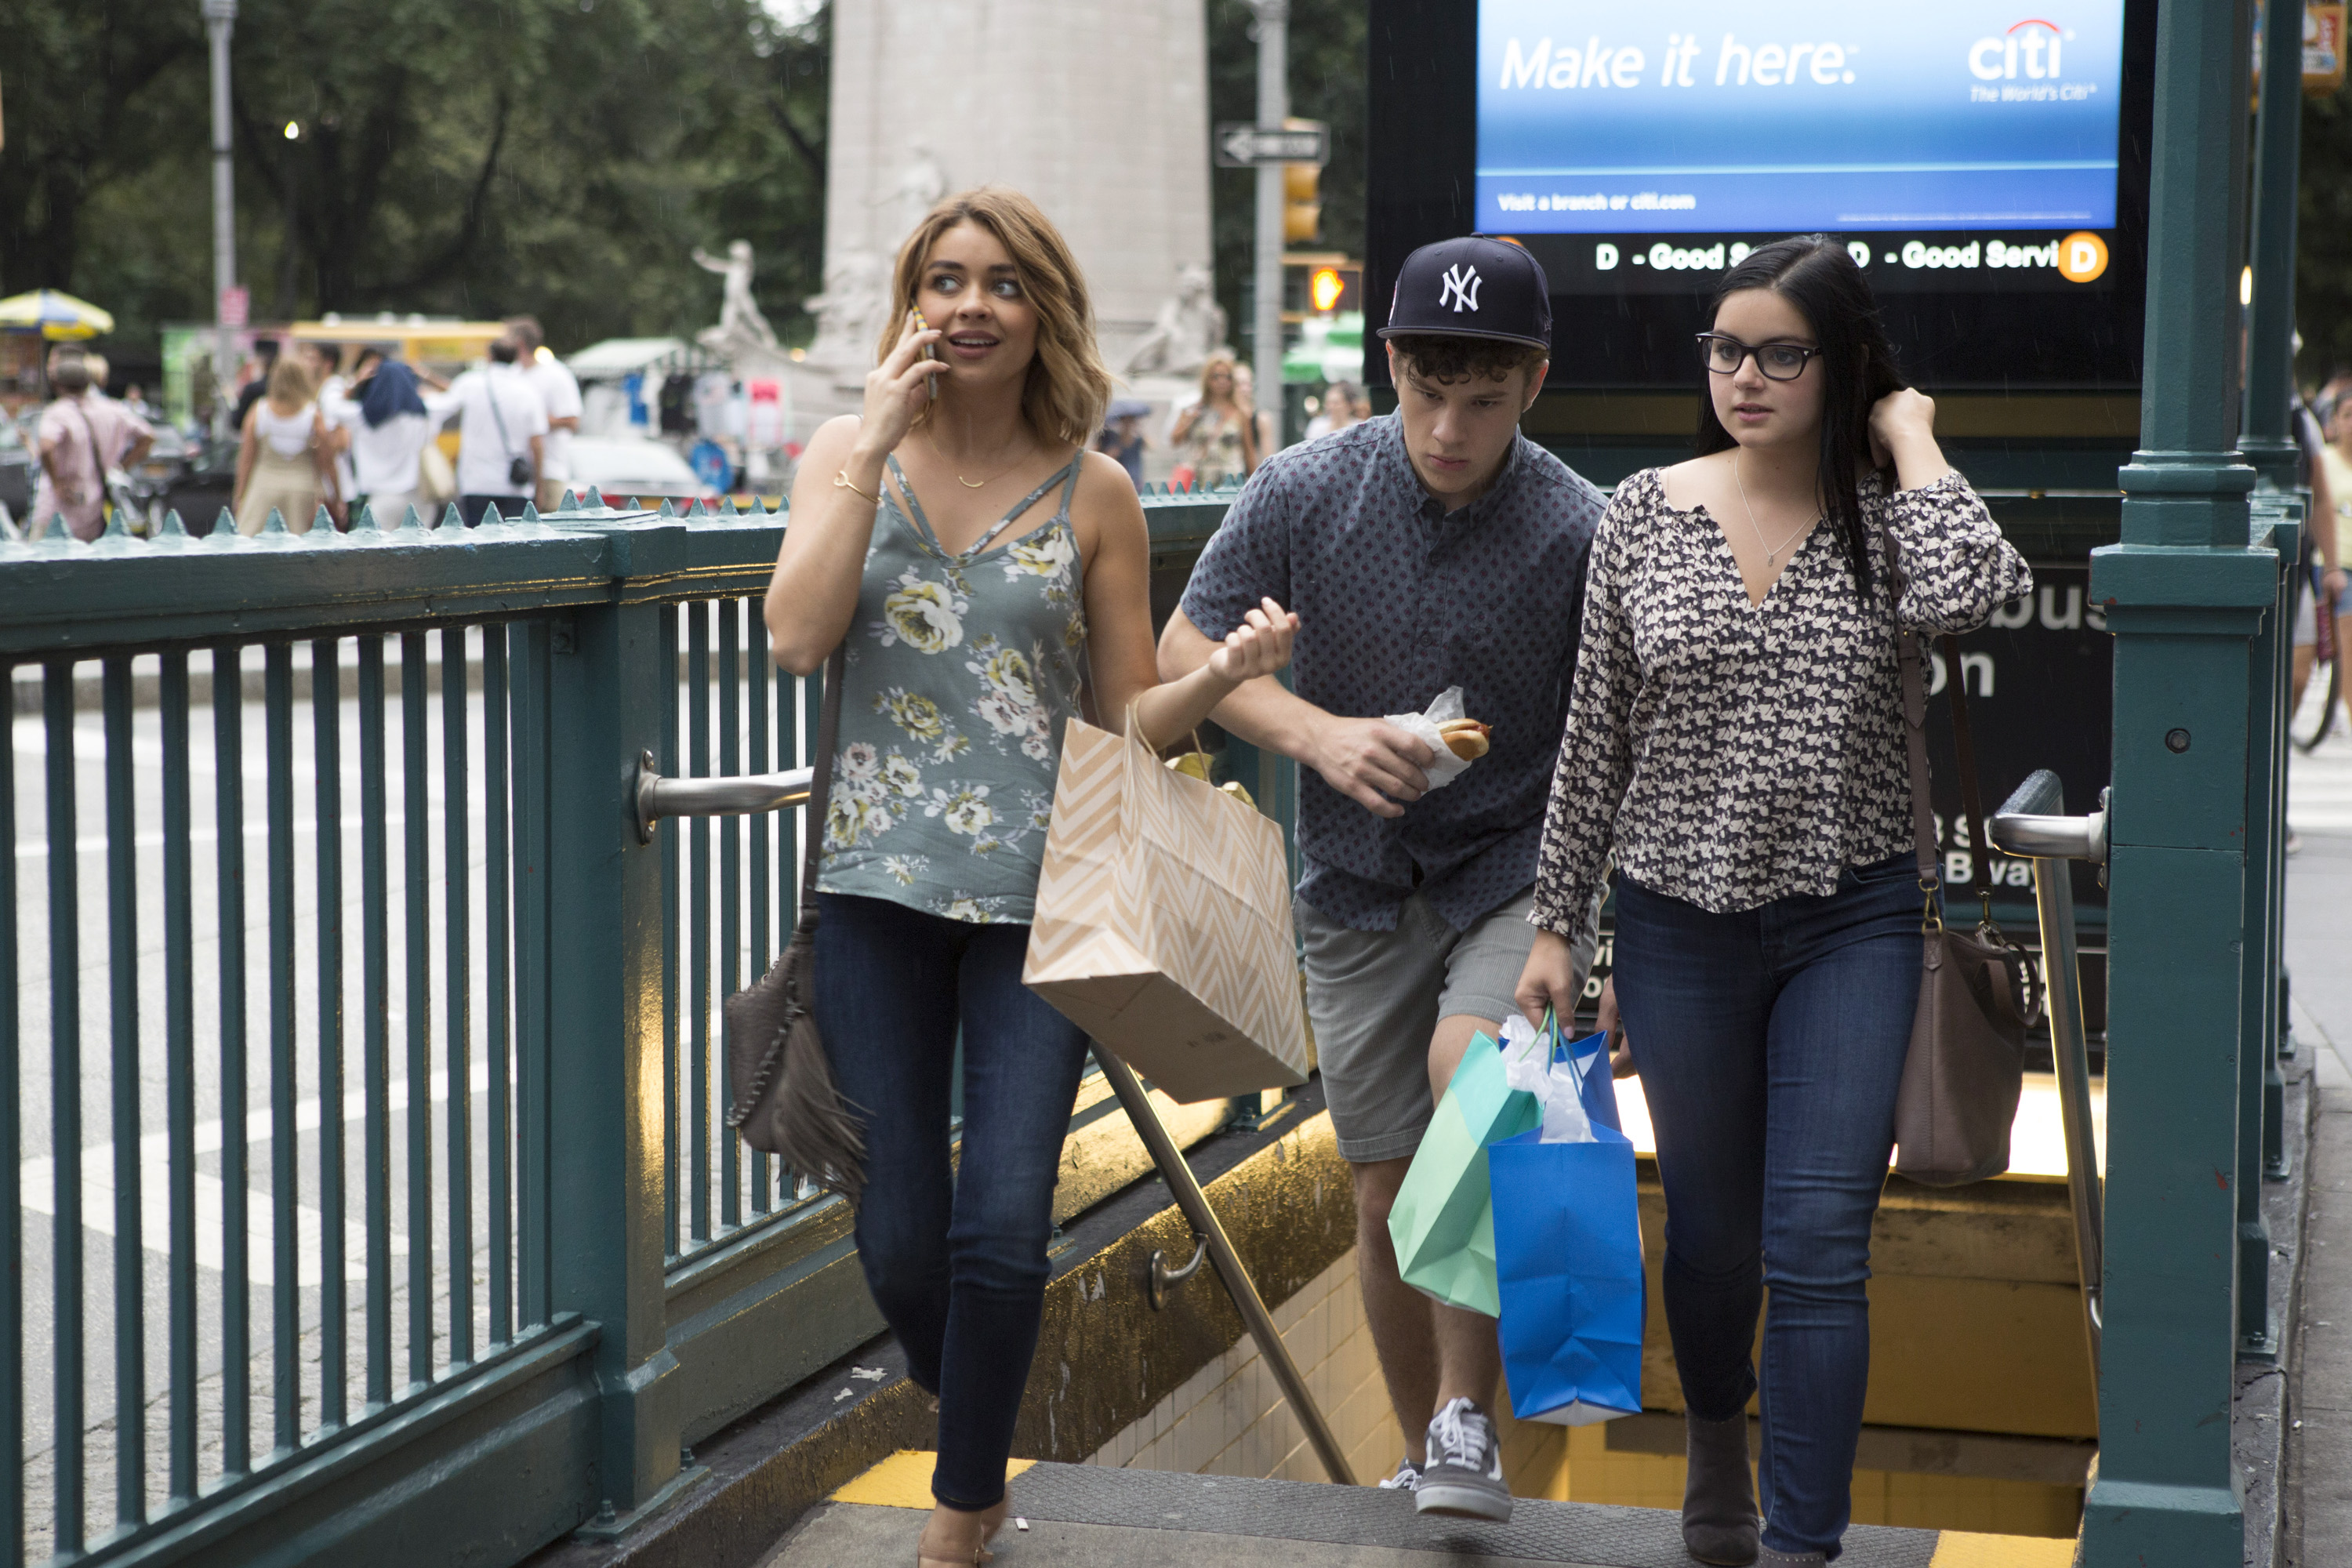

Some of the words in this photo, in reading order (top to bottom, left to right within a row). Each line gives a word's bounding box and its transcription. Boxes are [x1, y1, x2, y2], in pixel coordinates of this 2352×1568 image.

[1499, 34, 1646, 90] Make
[1661, 32, 1702, 88] it
[1969, 83, 2000, 103] The
[1497, 193, 1536, 212] Visit
[1537, 195, 1551, 212] a
[1551, 192, 1608, 211] branch
[1609, 195, 1630, 211] or
[1595, 242, 1620, 270] D
[1649, 241, 1725, 270] Good
[1901, 240, 1980, 268] Good
[2070, 241, 2098, 273] D
[1439, 263, 1483, 312] NY
